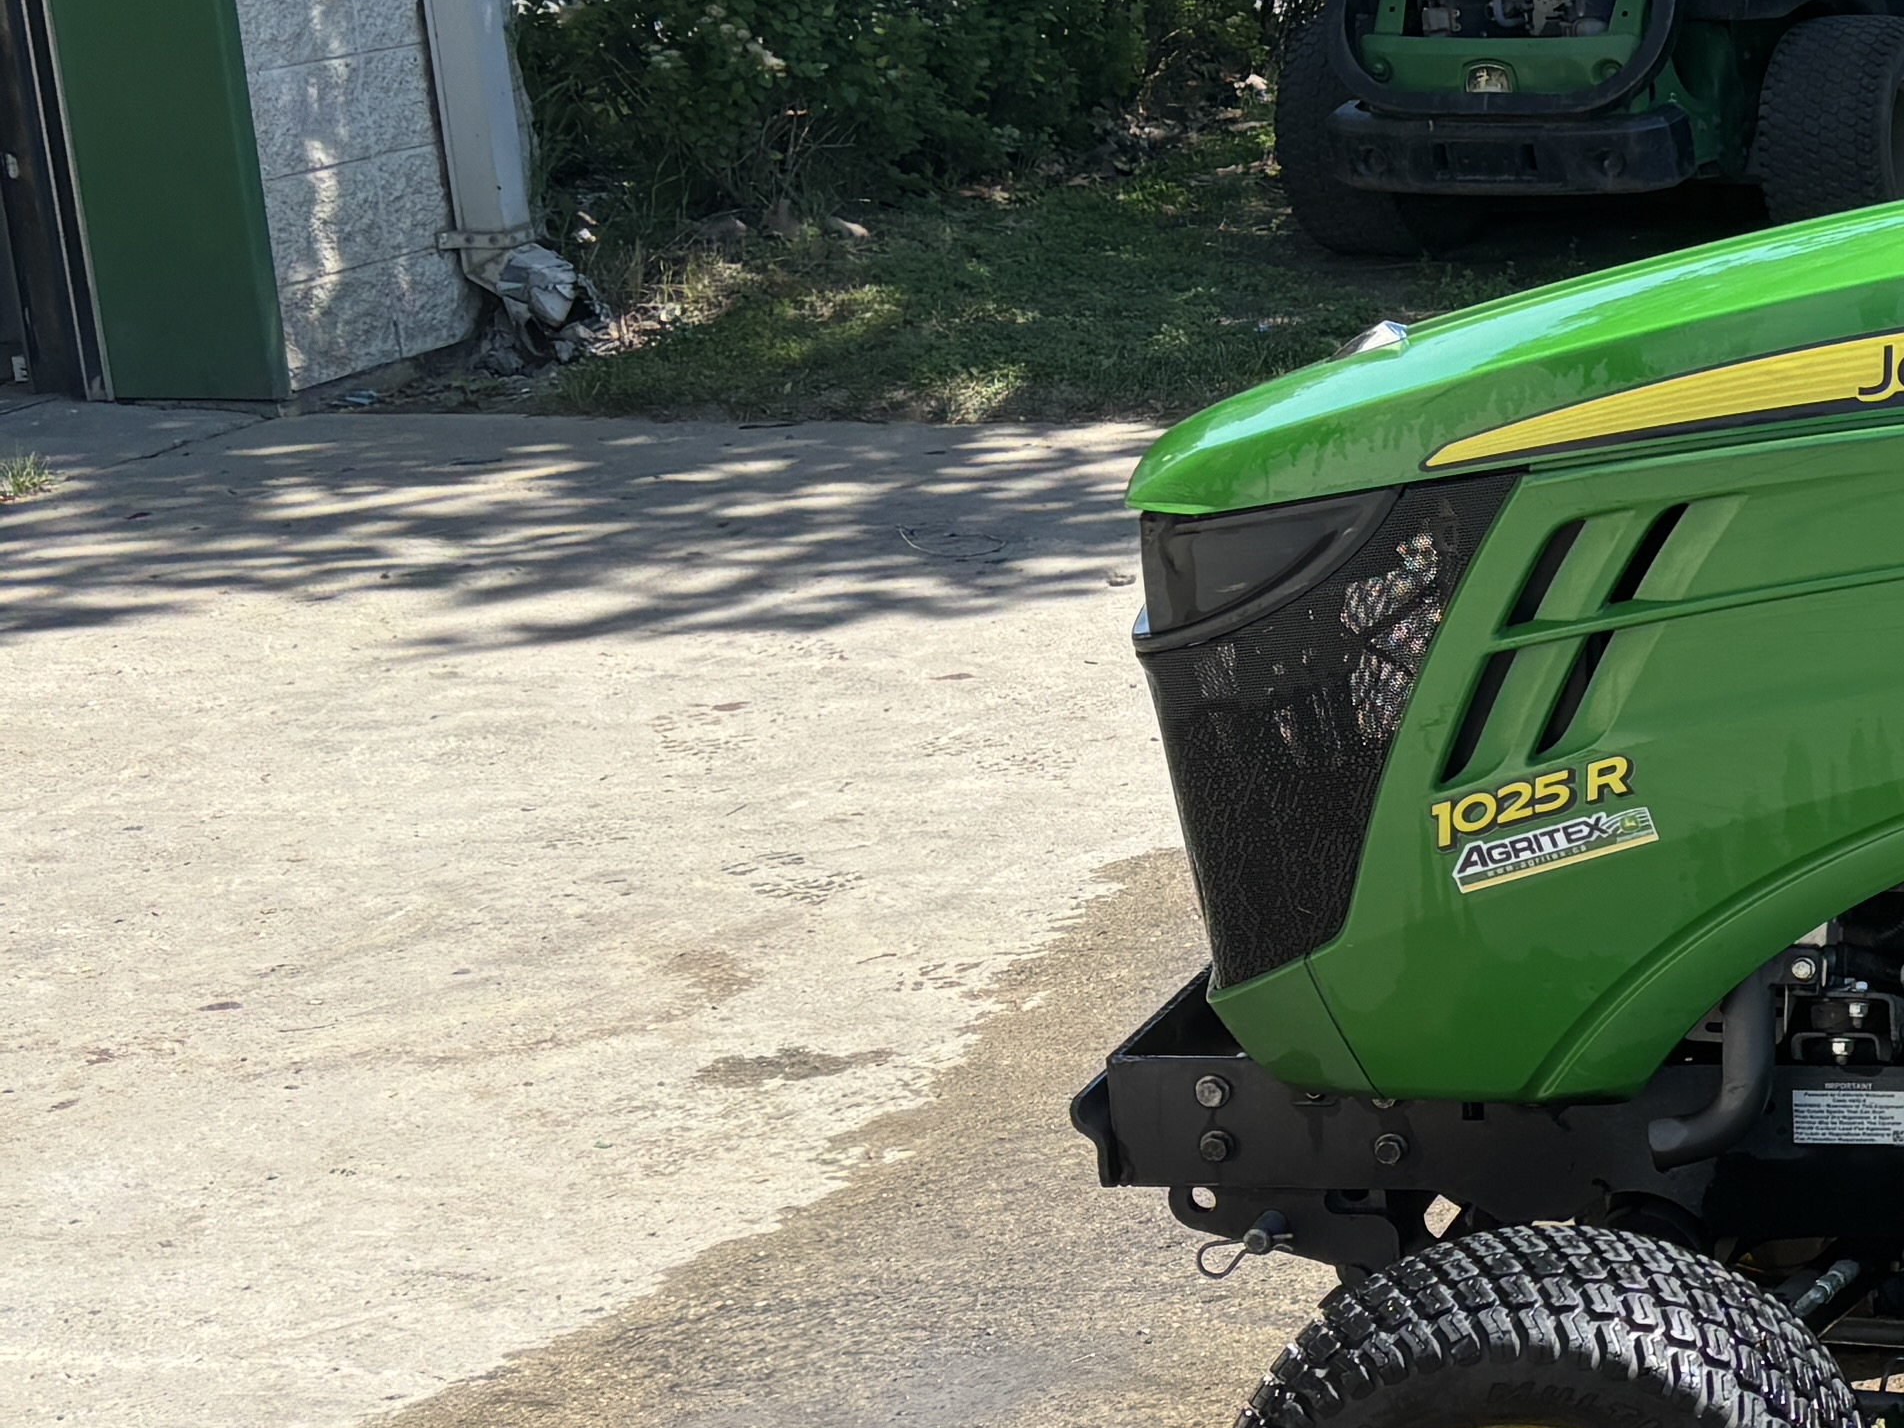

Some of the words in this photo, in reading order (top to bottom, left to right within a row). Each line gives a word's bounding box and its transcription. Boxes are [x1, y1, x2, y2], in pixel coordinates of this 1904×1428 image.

[1431, 769, 1575, 850] 1025
[1586, 756, 1633, 804] R
[1458, 815, 1609, 874] AGRITEX
